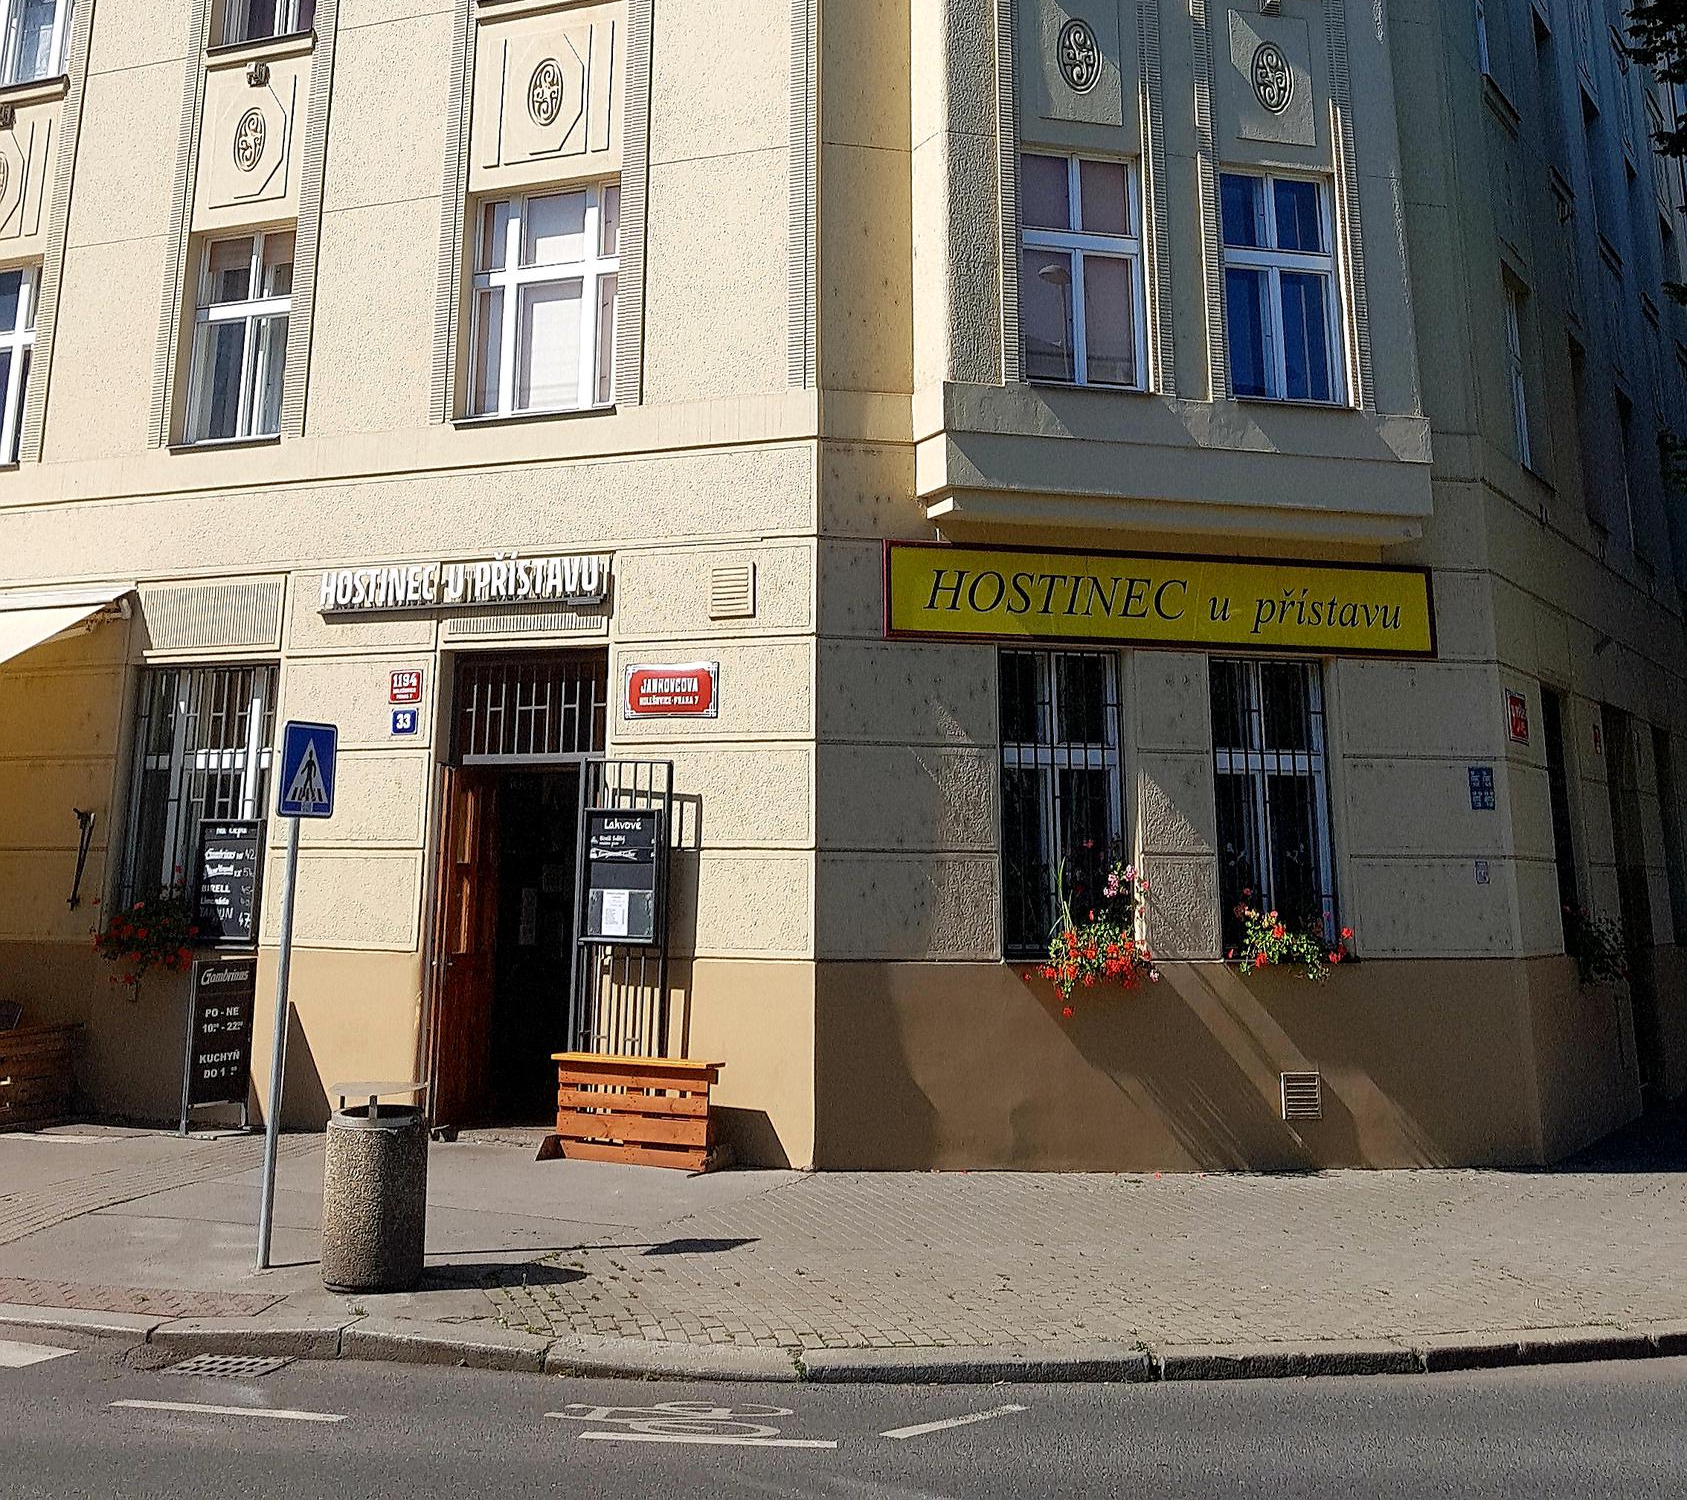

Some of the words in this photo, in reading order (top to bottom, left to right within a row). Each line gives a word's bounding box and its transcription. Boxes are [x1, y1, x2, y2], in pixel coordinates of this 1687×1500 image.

[320, 565, 438, 606] HOSTINEC
[449, 563, 465, 599] U
[475, 551, 600, 598] PŘÍSTAVU
[921, 568, 1189, 621] HOSTINEC
[1208, 596, 1232, 622] u
[1250, 587, 1402, 635] přístavu
[393, 673, 417, 688] 1194
[640, 677, 699, 694] JANKOVCOVA
[396, 713, 411, 729] 33
[205, 1008, 219, 1018] PO
[226, 1007, 240, 1016] NE
[204, 1069, 218, 1079] DO
